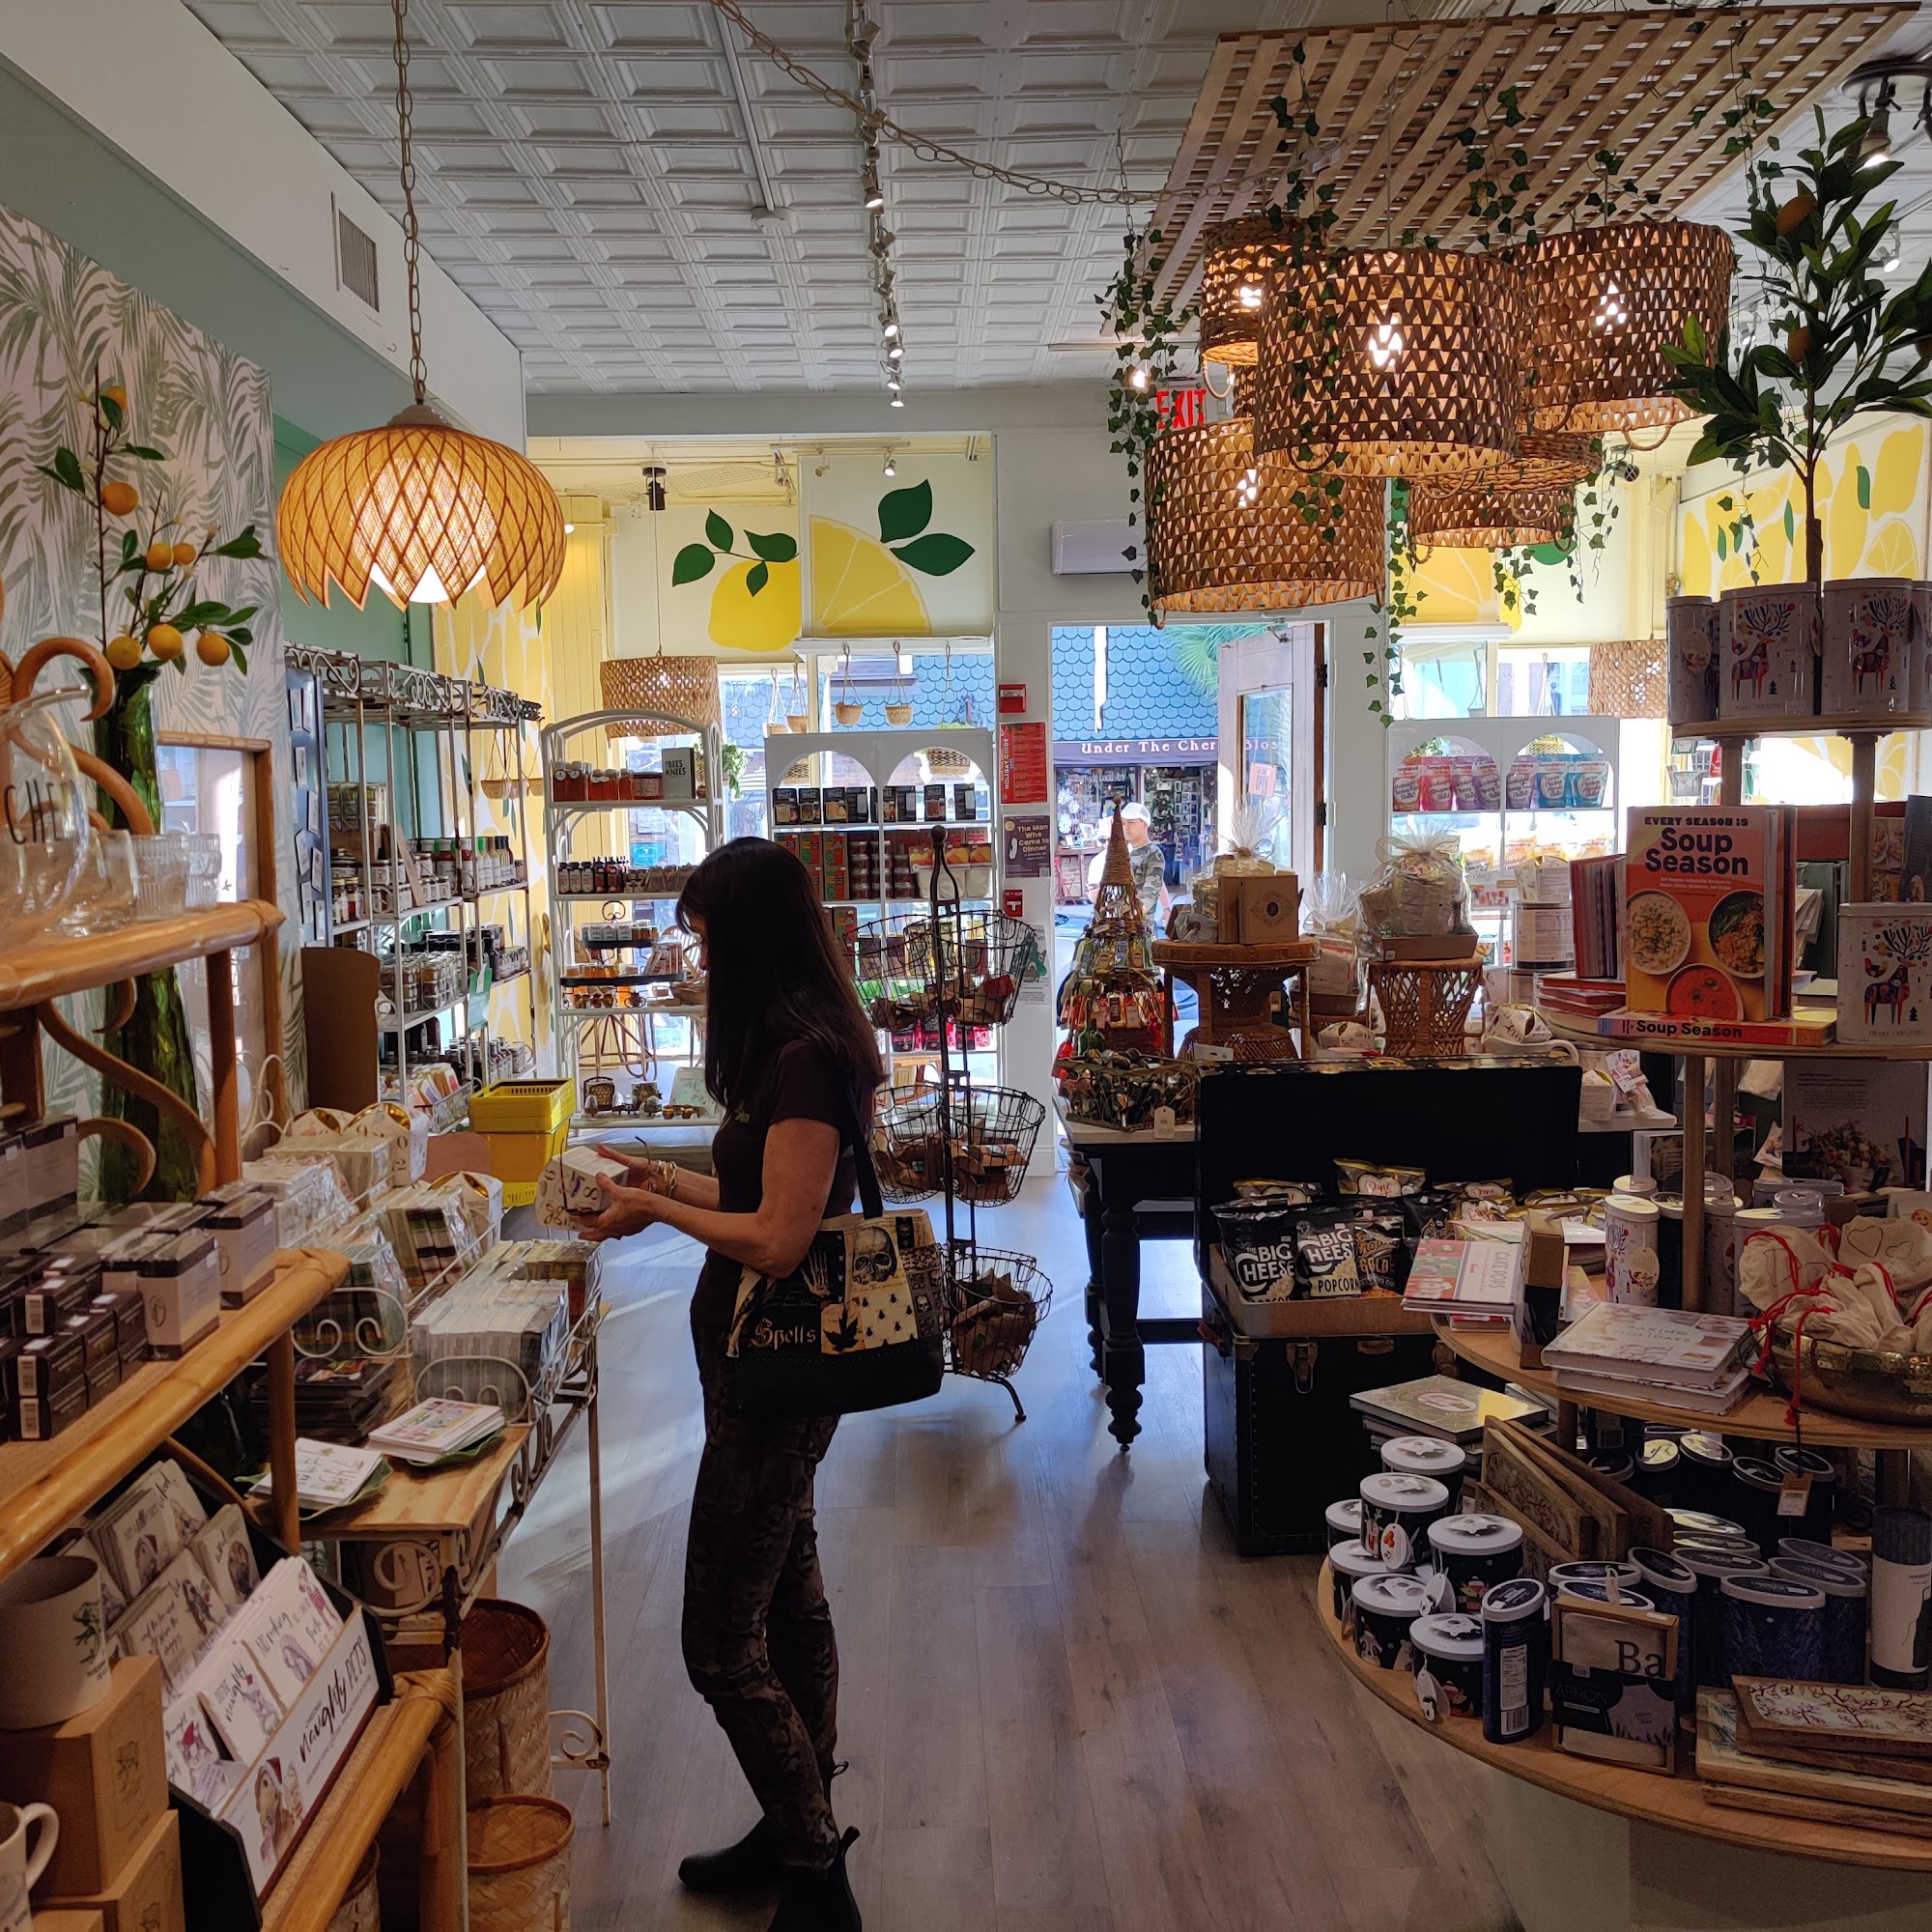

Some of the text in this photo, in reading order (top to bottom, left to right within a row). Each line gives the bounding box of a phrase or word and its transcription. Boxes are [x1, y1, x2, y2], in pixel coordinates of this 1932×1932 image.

[1156, 389, 1207, 429] EXIT
[1081, 742, 1129, 753] Under
[1138, 741, 1170, 753] The
[1178, 739, 1216, 752] Cher
[1686, 817, 1733, 826] SEASON
[1661, 827, 1733, 856] Soup
[1645, 848, 1748, 875] Season
[1635, 1019, 1743, 1038] Soup Season
[1319, 1228, 1354, 1247] BIG
[1258, 1242, 1293, 1263] BIG
[1296, 1239, 1354, 1273] CHEES
[1235, 1253, 1295, 1293] CHEESE
[1360, 1258, 1389, 1274] GOLD
[1489, 1251, 1511, 1289] CAKE POPS
[1318, 1277, 1360, 1293] POPCORN
[749, 1317, 816, 1350] Spells
[1614, 1329, 1690, 1343] HOLIDAYS
[1627, 1324, 1689, 1336] BAKING
[1614, 1639, 1664, 1678] Ba
[225, 1660, 247, 1723] naughty
[298, 1668, 347, 1763] naughty
[344, 1634, 369, 1690] PETS
[1554, 1683, 1608, 1705] APRON
